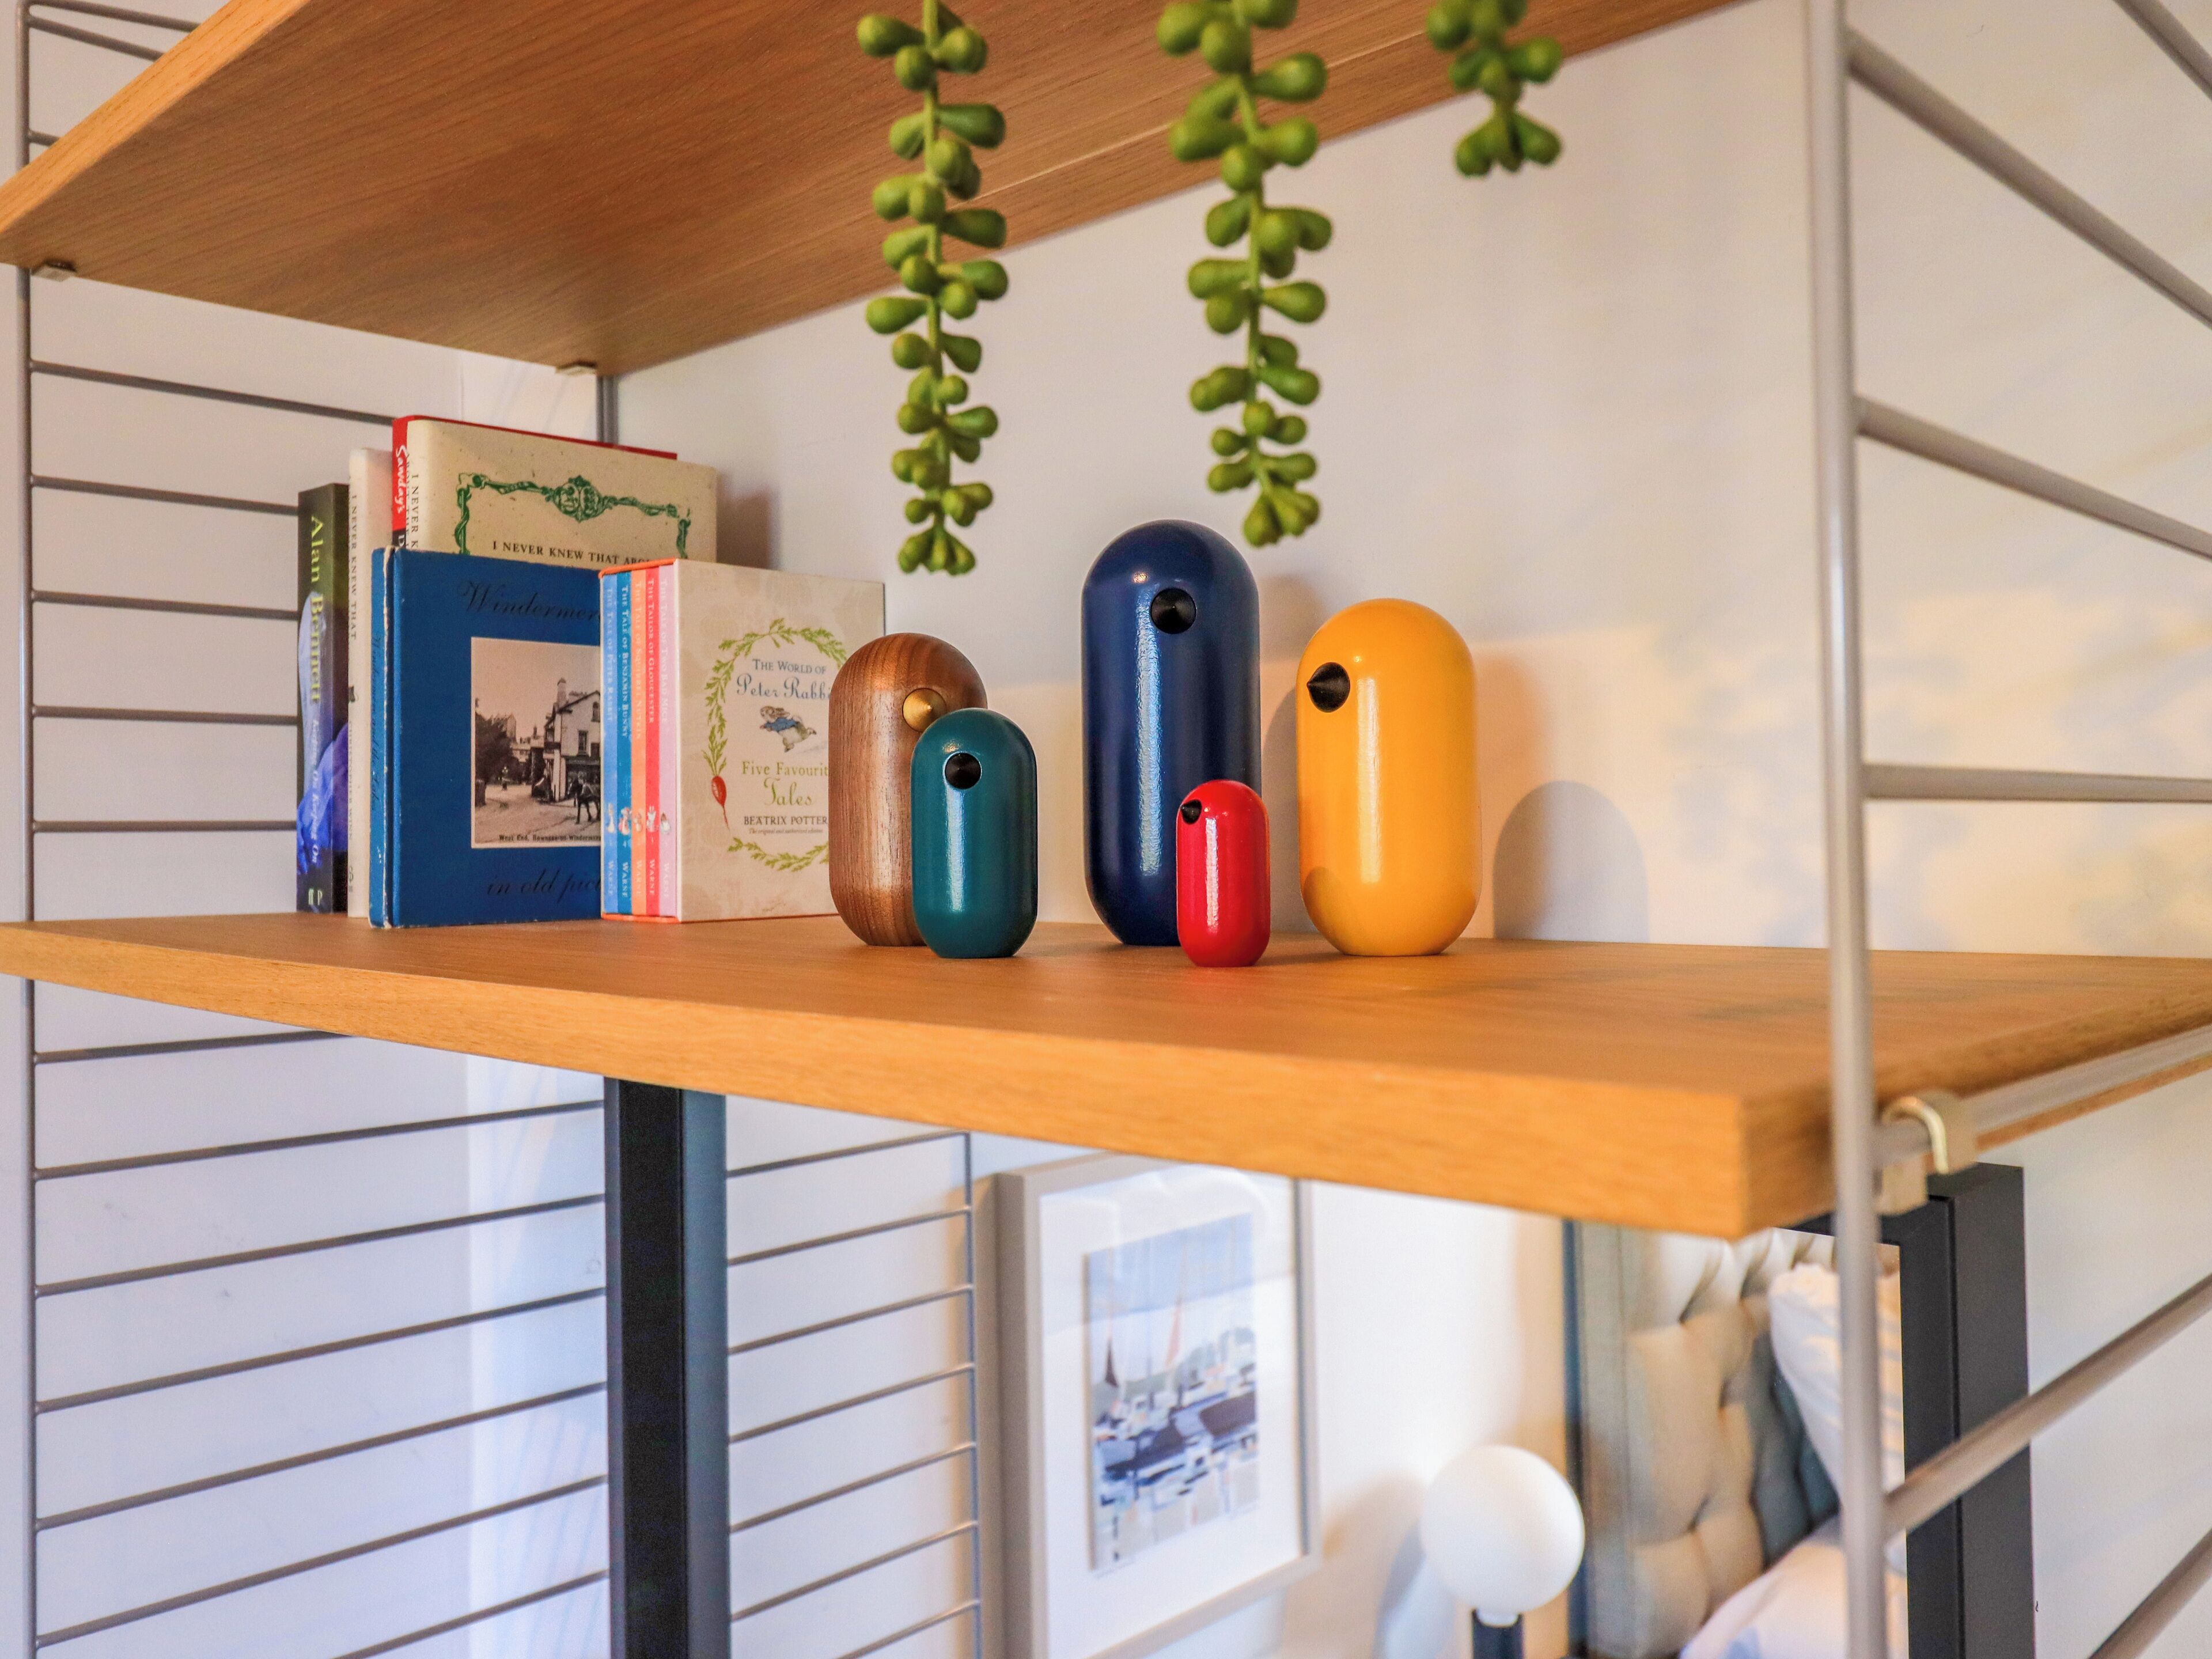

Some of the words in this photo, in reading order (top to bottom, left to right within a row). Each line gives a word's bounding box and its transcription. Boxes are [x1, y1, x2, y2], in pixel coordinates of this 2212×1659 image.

[395, 445, 407, 514] Sawday's
[411, 486, 419, 533] NEVER
[311, 516, 324, 583] Alan
[493, 541, 497, 550] I
[503, 541, 544, 556] NEVER
[549, 548, 585, 560] KNEW
[588, 552, 620, 565] THAT
[310, 594, 324, 702] Bennett
[622, 637, 628, 649] OF
[648, 642, 654, 654] OF
[752, 658, 774, 671] THE
[778, 661, 812, 674] WORLD
[815, 665, 827, 674] OF
[737, 673, 778, 698] Peter
[743, 760, 770, 775] Five
[763, 777, 816, 806] Tales
[744, 816, 787, 825] BEATRIX
[791, 816, 828, 825] POTTER
[487, 874, 510, 895] in
[520, 868, 561, 893] old
